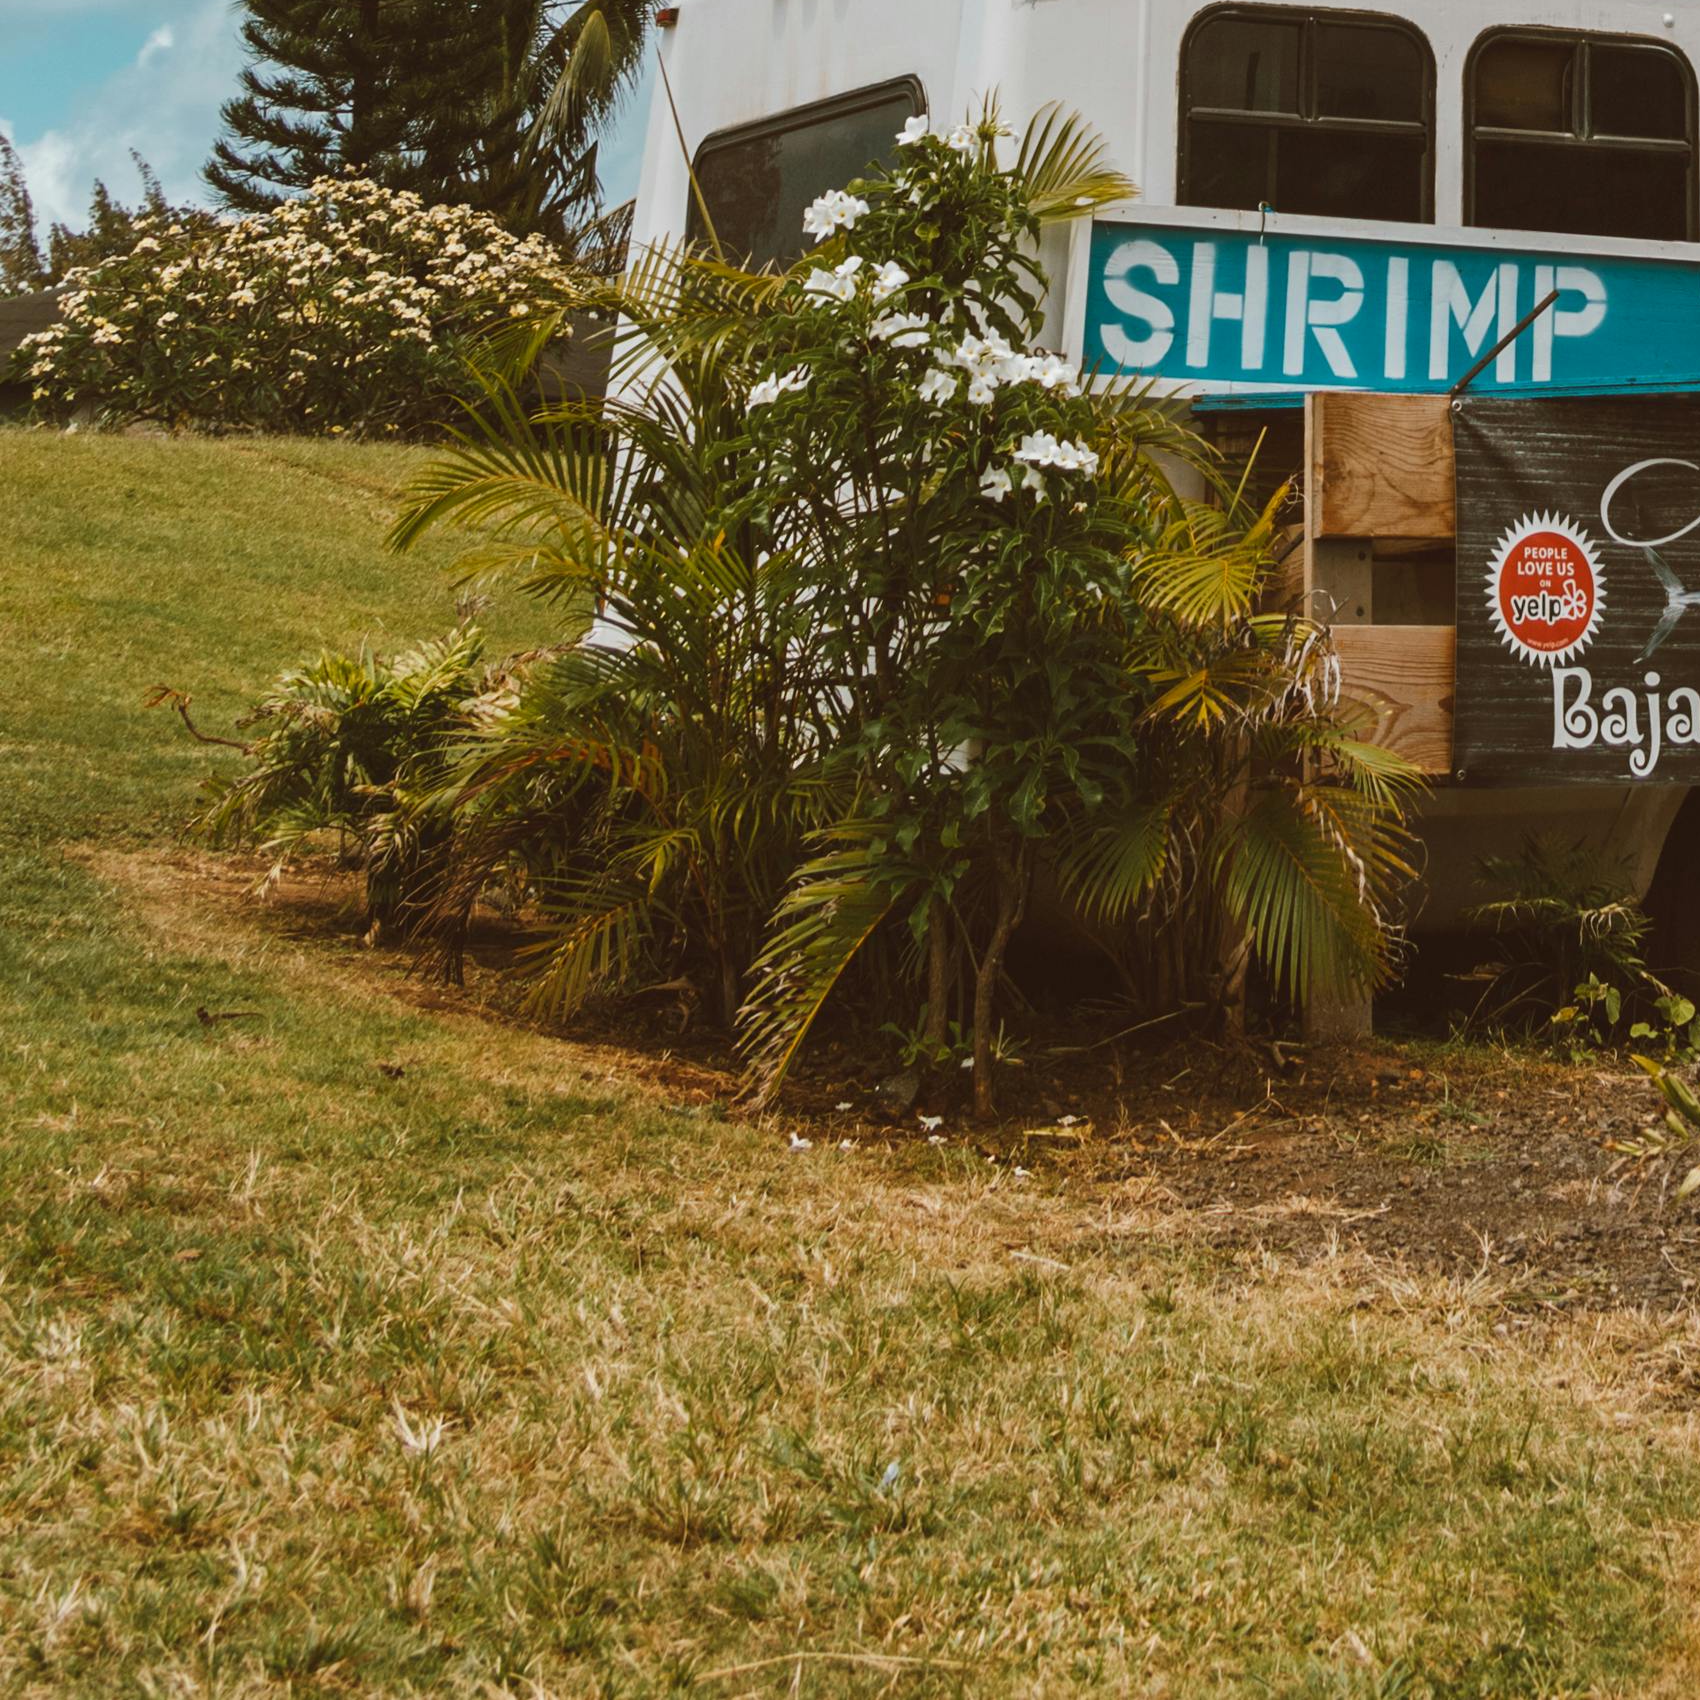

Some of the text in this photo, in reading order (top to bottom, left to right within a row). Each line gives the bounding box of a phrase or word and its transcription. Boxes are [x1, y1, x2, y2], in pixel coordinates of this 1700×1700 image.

[1101, 237, 1608, 383] SHRIMP
[1524, 547, 1568, 559] PEOPLE
[1517, 562, 1575, 576] LOVE US
[1539, 579, 1551, 588] ON
[1512, 591, 1563, 624] yelp
